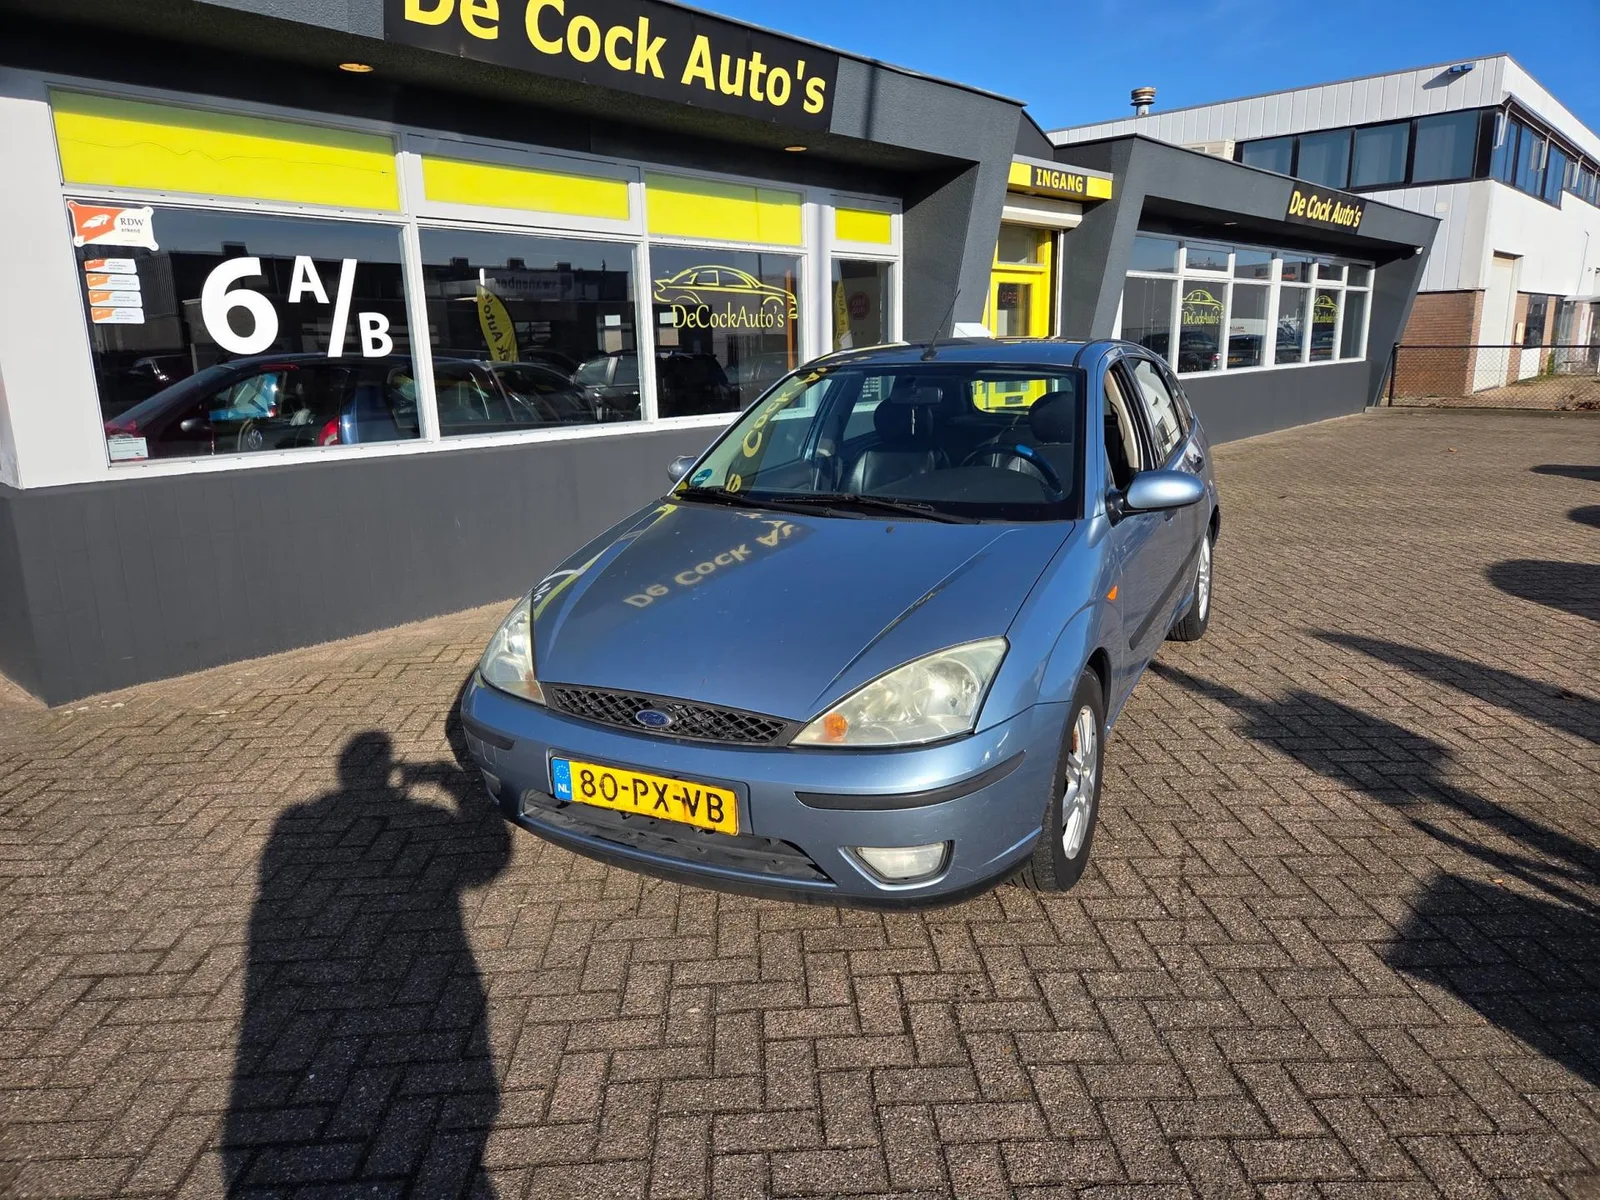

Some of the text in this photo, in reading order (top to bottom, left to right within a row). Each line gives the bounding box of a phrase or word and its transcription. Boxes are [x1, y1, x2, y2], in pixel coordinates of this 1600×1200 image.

[525, 0, 667, 79] Cock
[681, 34, 826, 114] Auto's
[1036, 168, 1083, 193] INGANG
[120, 217, 145, 226] RDW
[1289, 190, 1362, 227] De Cock Auto's
[201, 256, 279, 355] 6
[557, 783, 570, 793] NL
[580, 769, 725, 824] 80-PX-VB
